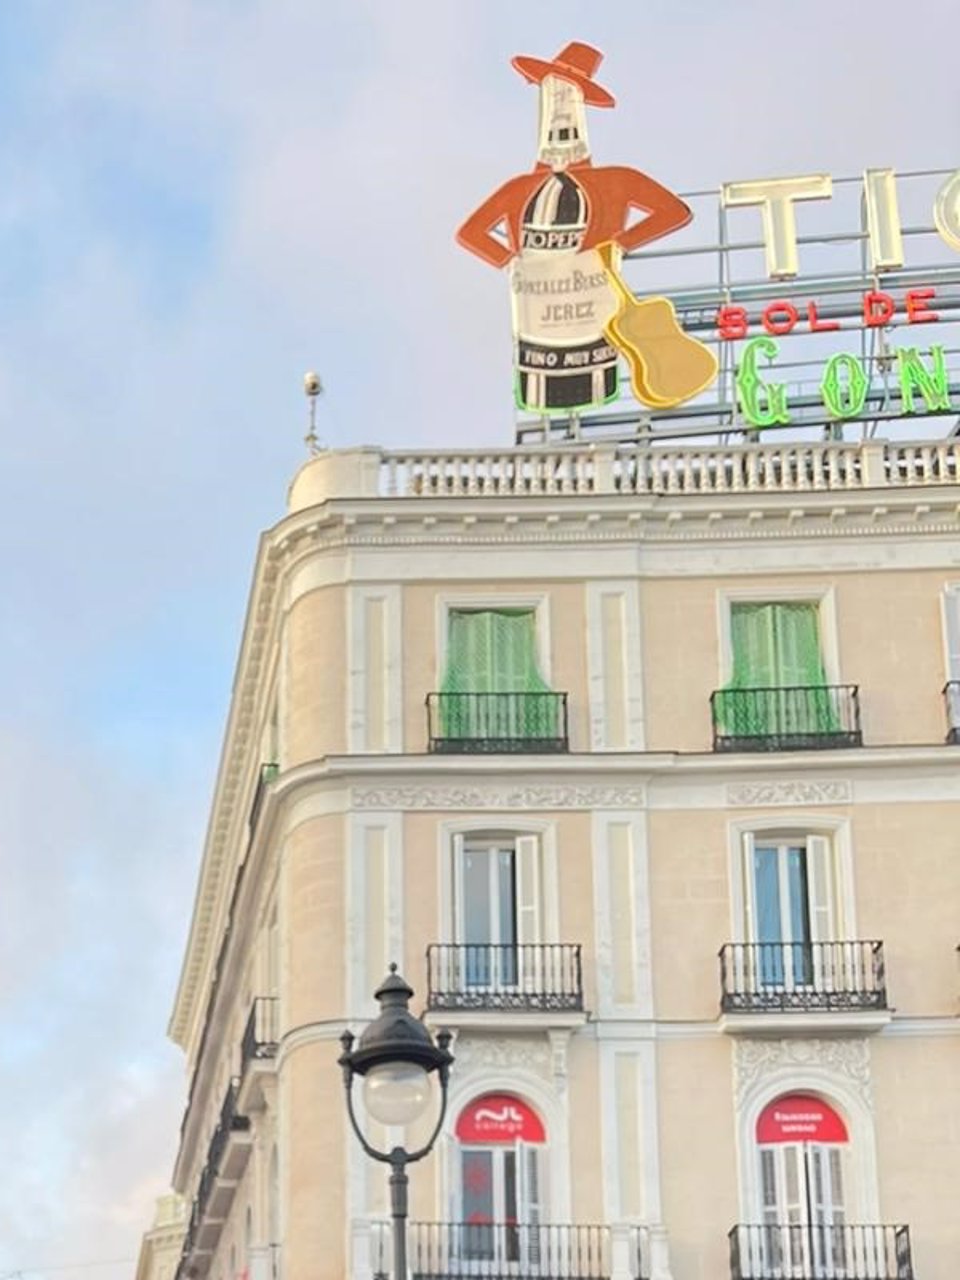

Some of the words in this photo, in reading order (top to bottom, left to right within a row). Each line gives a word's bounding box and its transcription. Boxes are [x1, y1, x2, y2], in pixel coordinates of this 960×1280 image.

[541, 301, 595, 321] JEREZ
[717, 301, 840, 340] SOL
[863, 288, 939, 327] DE
